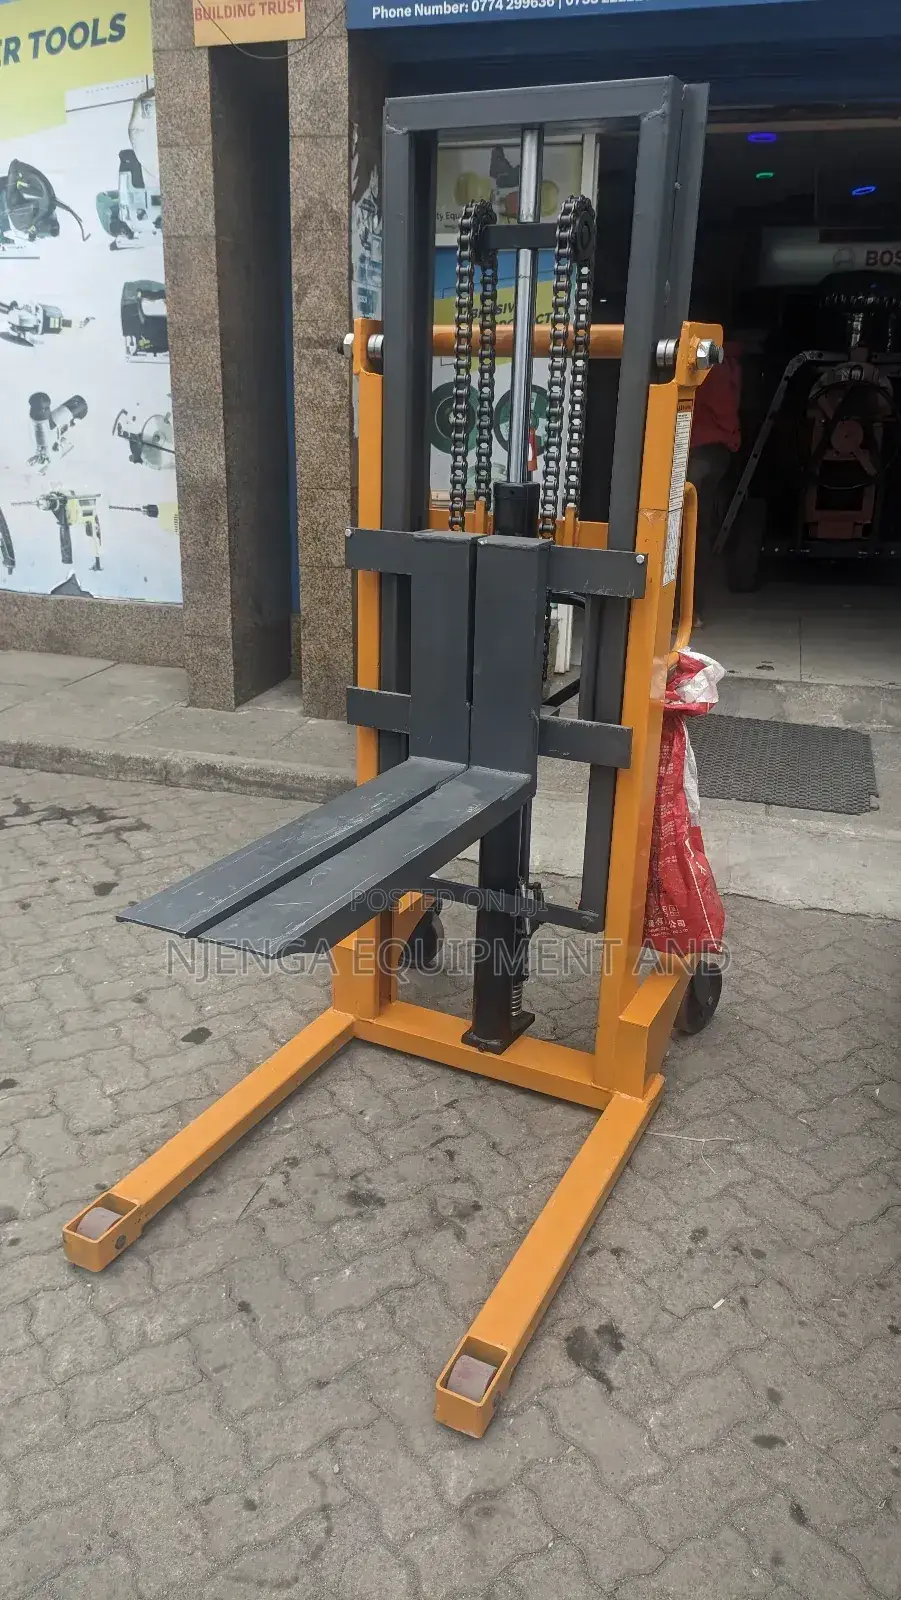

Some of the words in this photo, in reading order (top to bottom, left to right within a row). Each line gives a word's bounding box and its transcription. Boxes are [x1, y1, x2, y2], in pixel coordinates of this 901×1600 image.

[194, 2, 256, 21] BUILDING
[258, 0, 304, 16] TRUST
[372, 6, 412, 19] Phone
[414, 2, 469, 17] Number:
[471, 0, 504, 13] 0774
[0, 32, 21, 73] R
[28, 13, 127, 59] TOOLS
